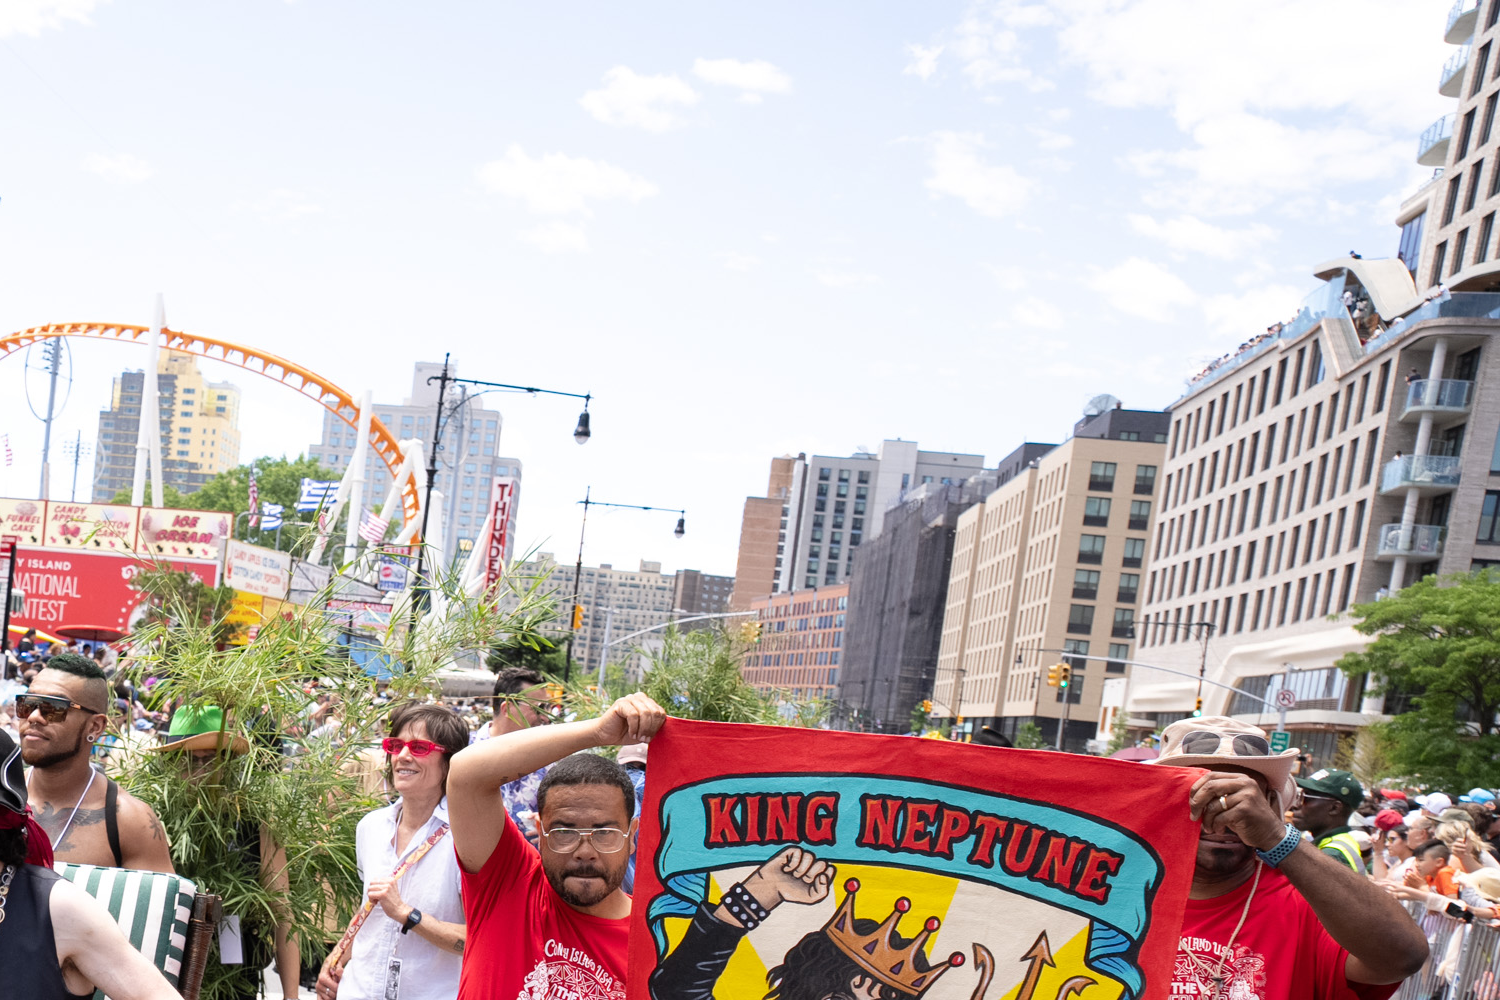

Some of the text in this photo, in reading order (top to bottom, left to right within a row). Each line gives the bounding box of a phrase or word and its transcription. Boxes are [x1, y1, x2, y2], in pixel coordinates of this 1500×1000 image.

[54, 506, 87, 514] CANDY
[172, 515, 200, 528] ICE
[11, 524, 35, 533] CAKE
[155, 530, 214, 544] CREAM
[27, 558, 72, 571] ISLAND
[701, 791, 1126, 905] KING NEPTUNE
[1169, 981, 1198, 994] THE
